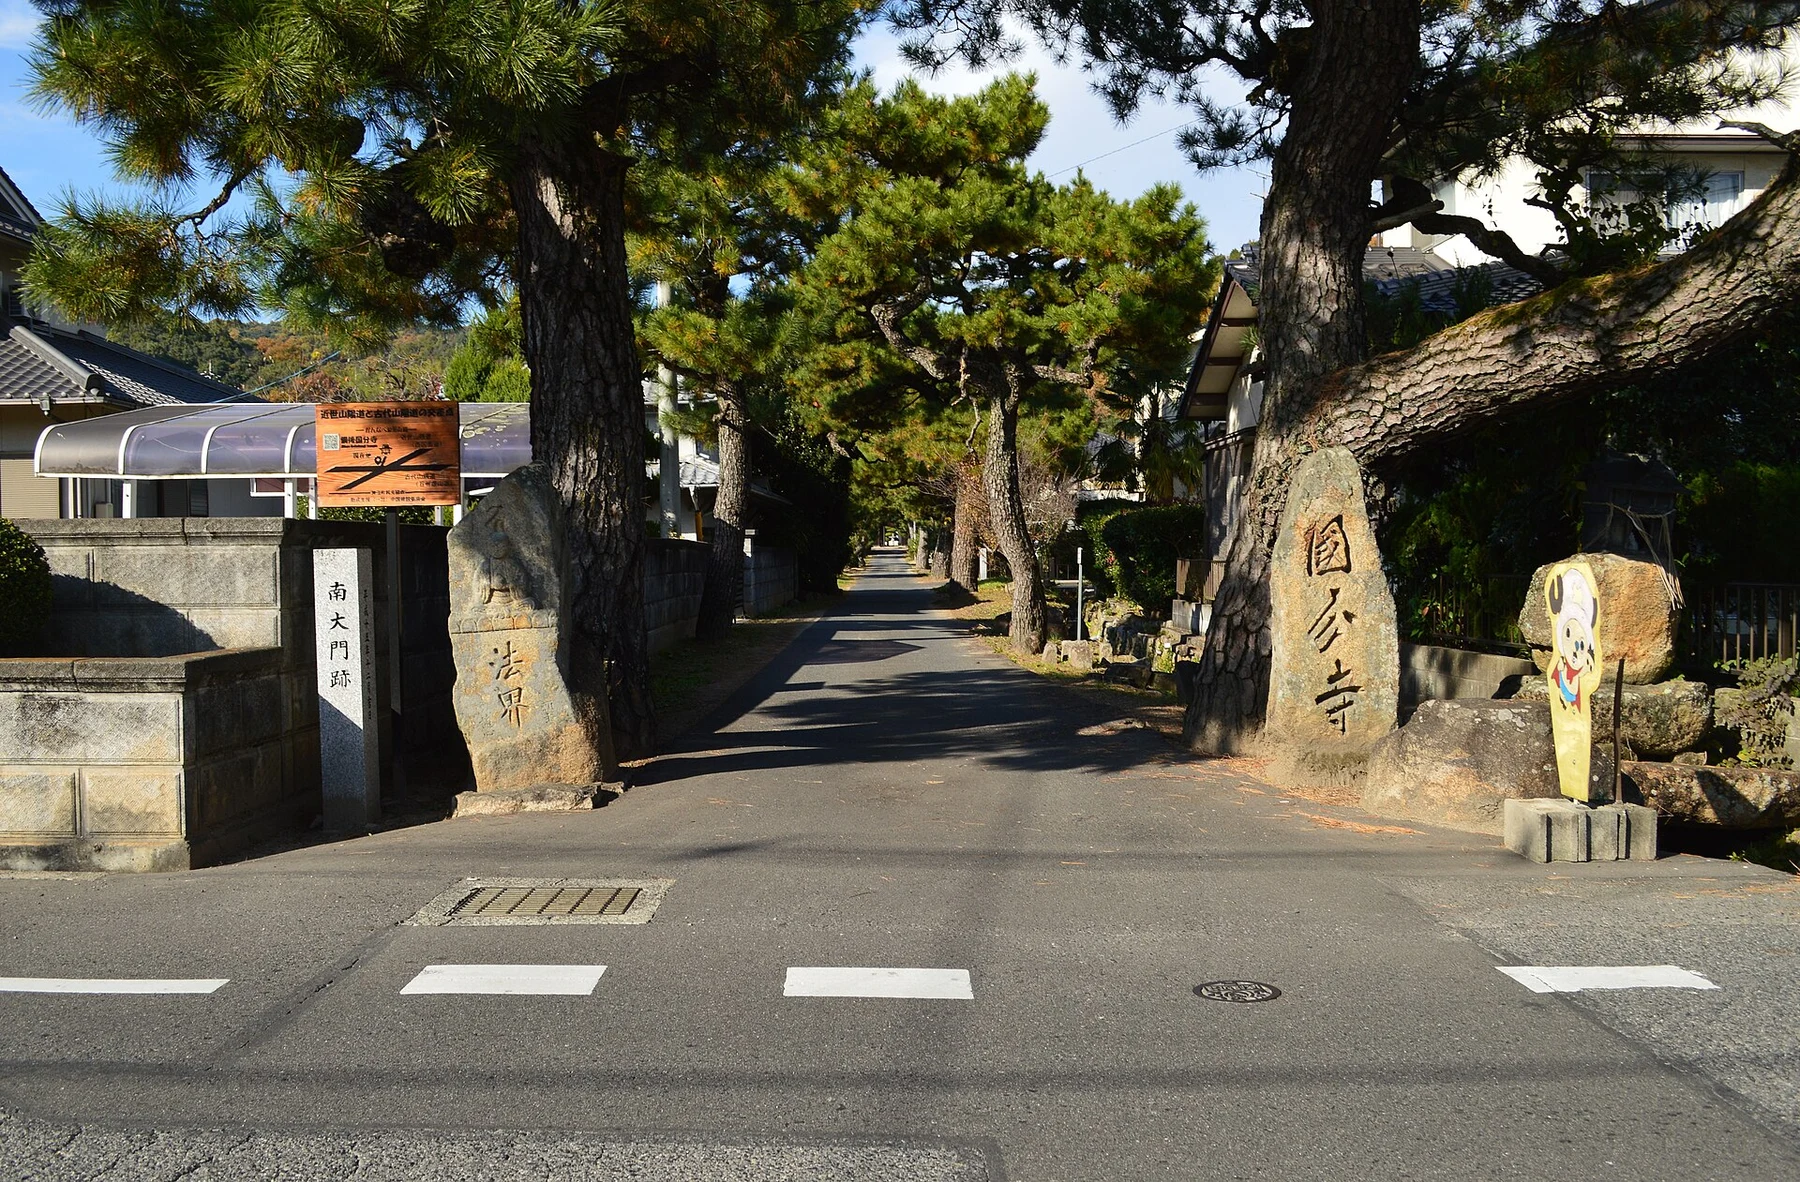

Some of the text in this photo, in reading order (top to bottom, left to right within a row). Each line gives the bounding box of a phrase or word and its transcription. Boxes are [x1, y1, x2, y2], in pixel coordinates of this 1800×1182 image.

[328, 581, 352, 689] 南大門跡
[488, 640, 528, 730] 法界
